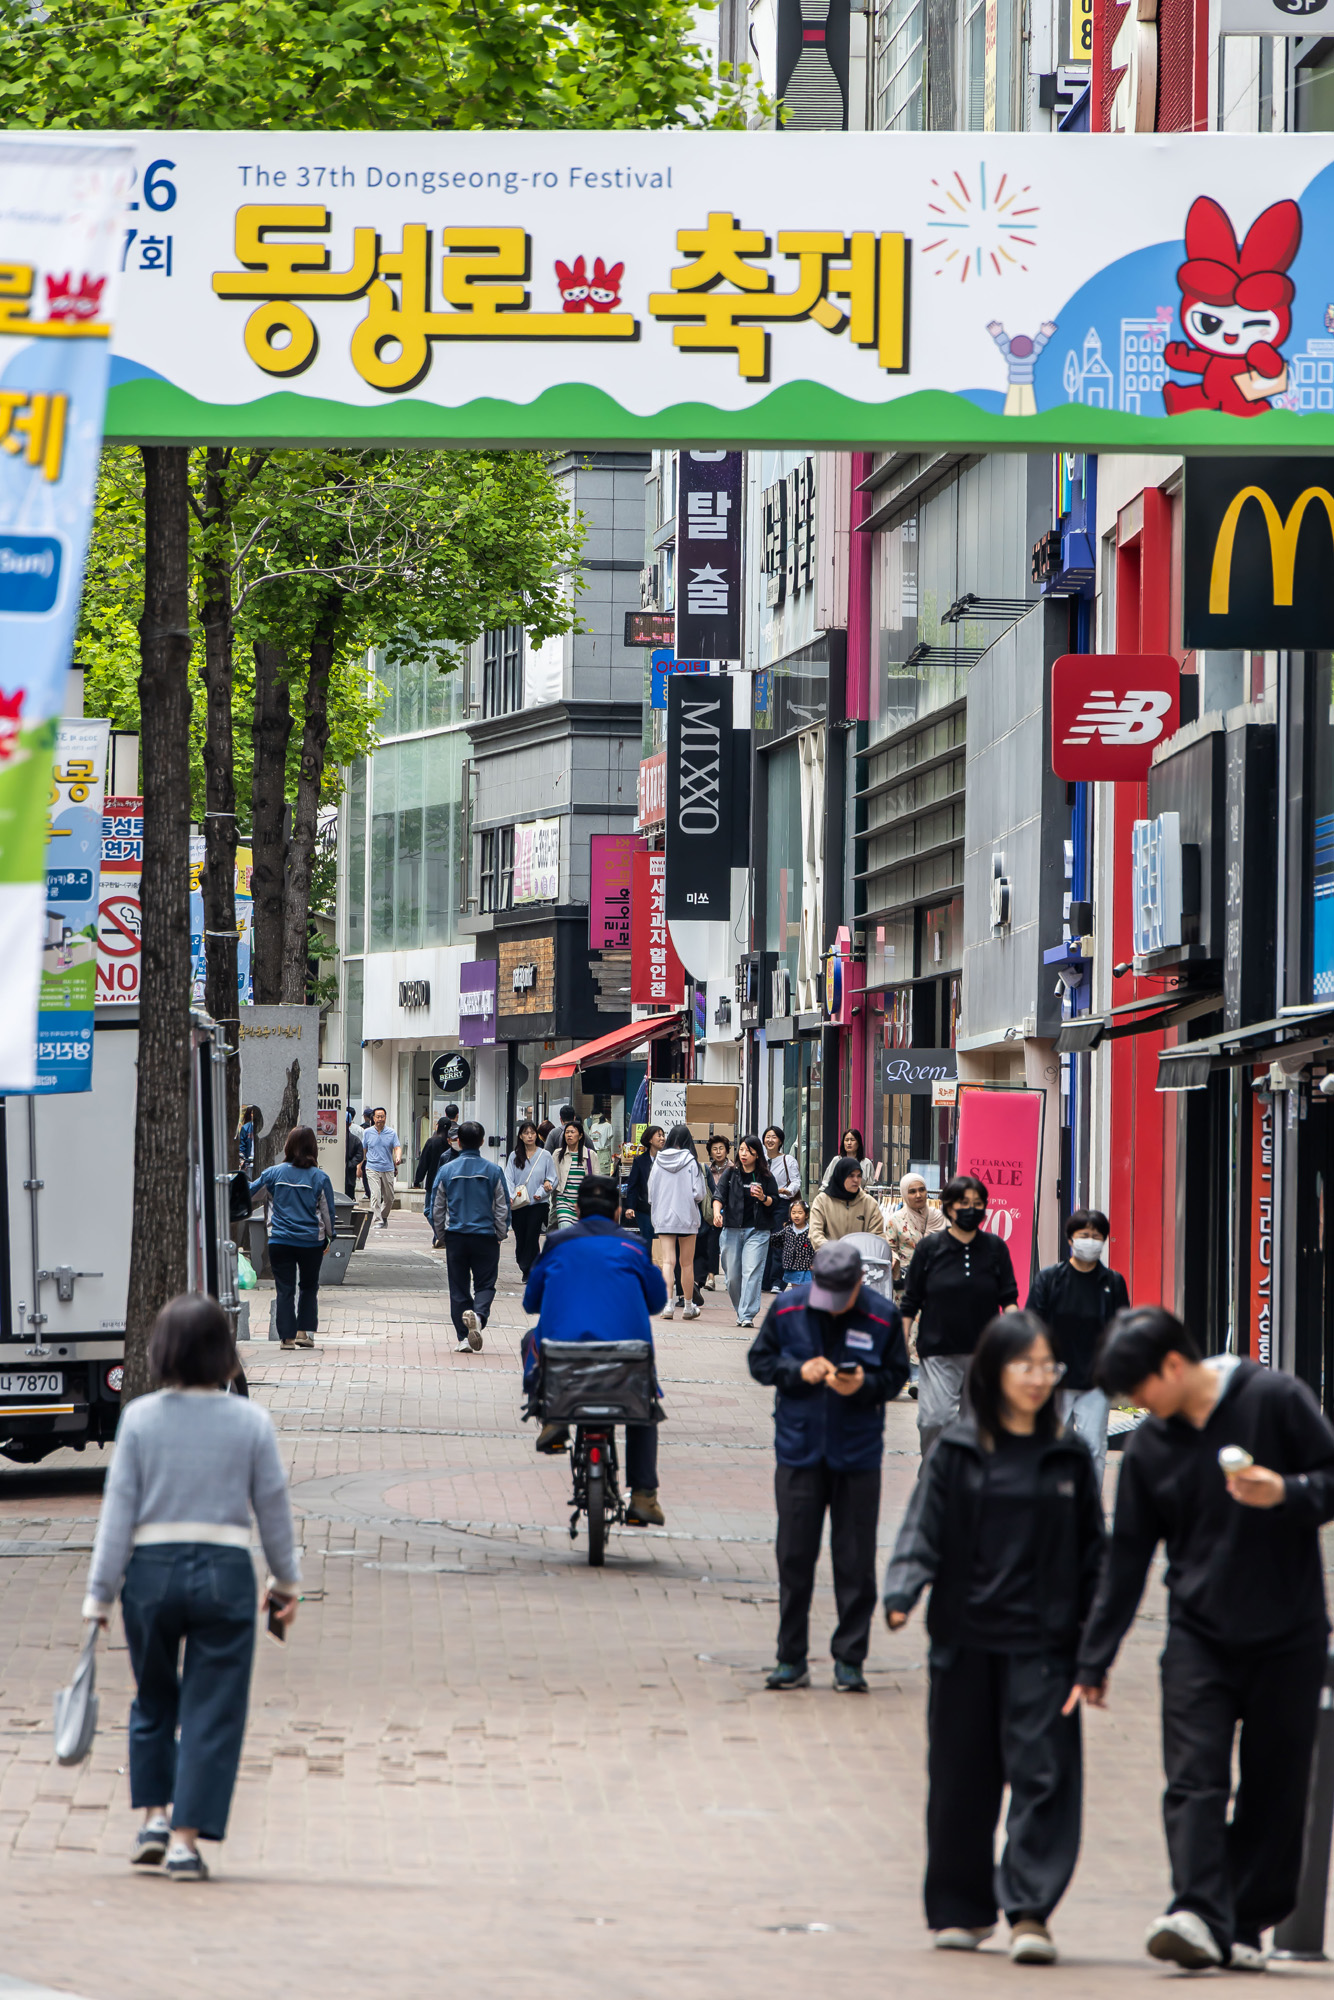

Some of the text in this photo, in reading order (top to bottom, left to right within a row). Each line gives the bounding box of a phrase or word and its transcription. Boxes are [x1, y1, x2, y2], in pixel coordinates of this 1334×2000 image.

[237, 164, 672, 195] The 37th Dongseong-ro Festival
[212, 204, 911, 394] 동성로 축제
[685, 449, 731, 615] 탈출
[679, 699, 720, 835] MIXXO
[686, 892, 709, 905] 미쏘
[96, 963, 138, 992] NO
[439, 1070, 463, 1081] BERRY
[443, 1066, 459, 1074] OAK
[886, 1059, 958, 1083] Roem
[654, 1109, 686, 1117] OPENNI
[970, 1158, 1023, 1169] CLEARANCE
[970, 1168, 1023, 1187] SALE
[17, 1374, 58, 1391] 7870
